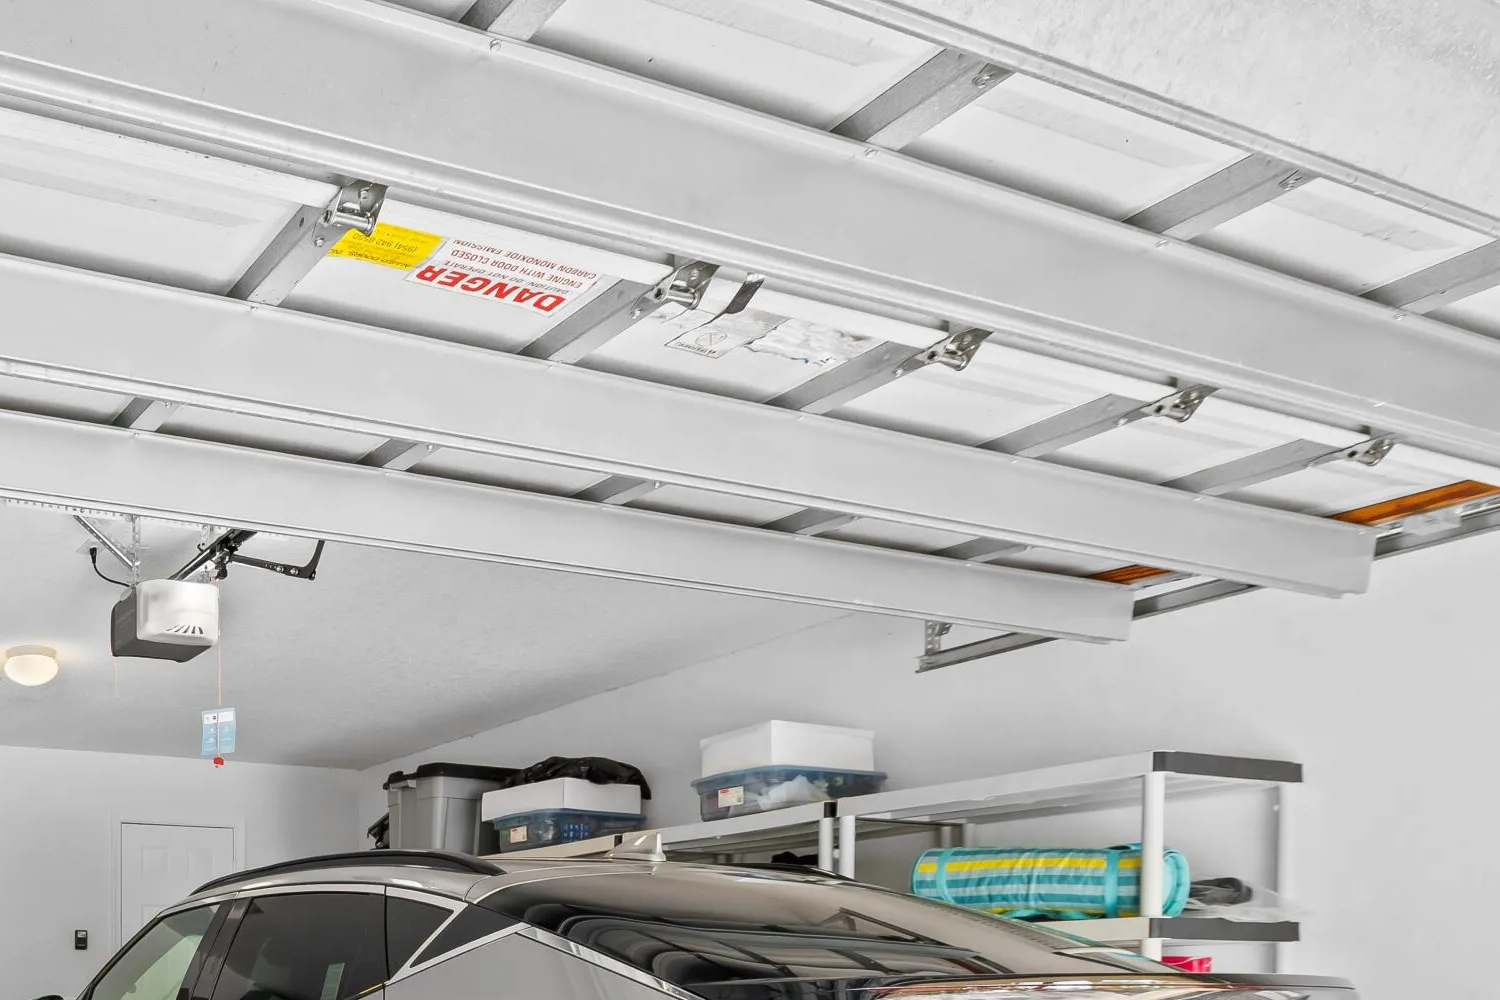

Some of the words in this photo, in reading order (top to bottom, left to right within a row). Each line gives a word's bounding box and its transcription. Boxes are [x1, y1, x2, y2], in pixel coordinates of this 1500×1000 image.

[450, 249, 490, 265] CLOSED
[503, 250, 558, 270] MONOXIDE
[490, 259, 520, 272] DOOR
[556, 265, 597, 280] CARBON
[487, 270, 509, 280] NOT
[518, 267, 546, 280] WITH
[415, 265, 567, 313] DANGER
[545, 274, 584, 289] ENGINE
